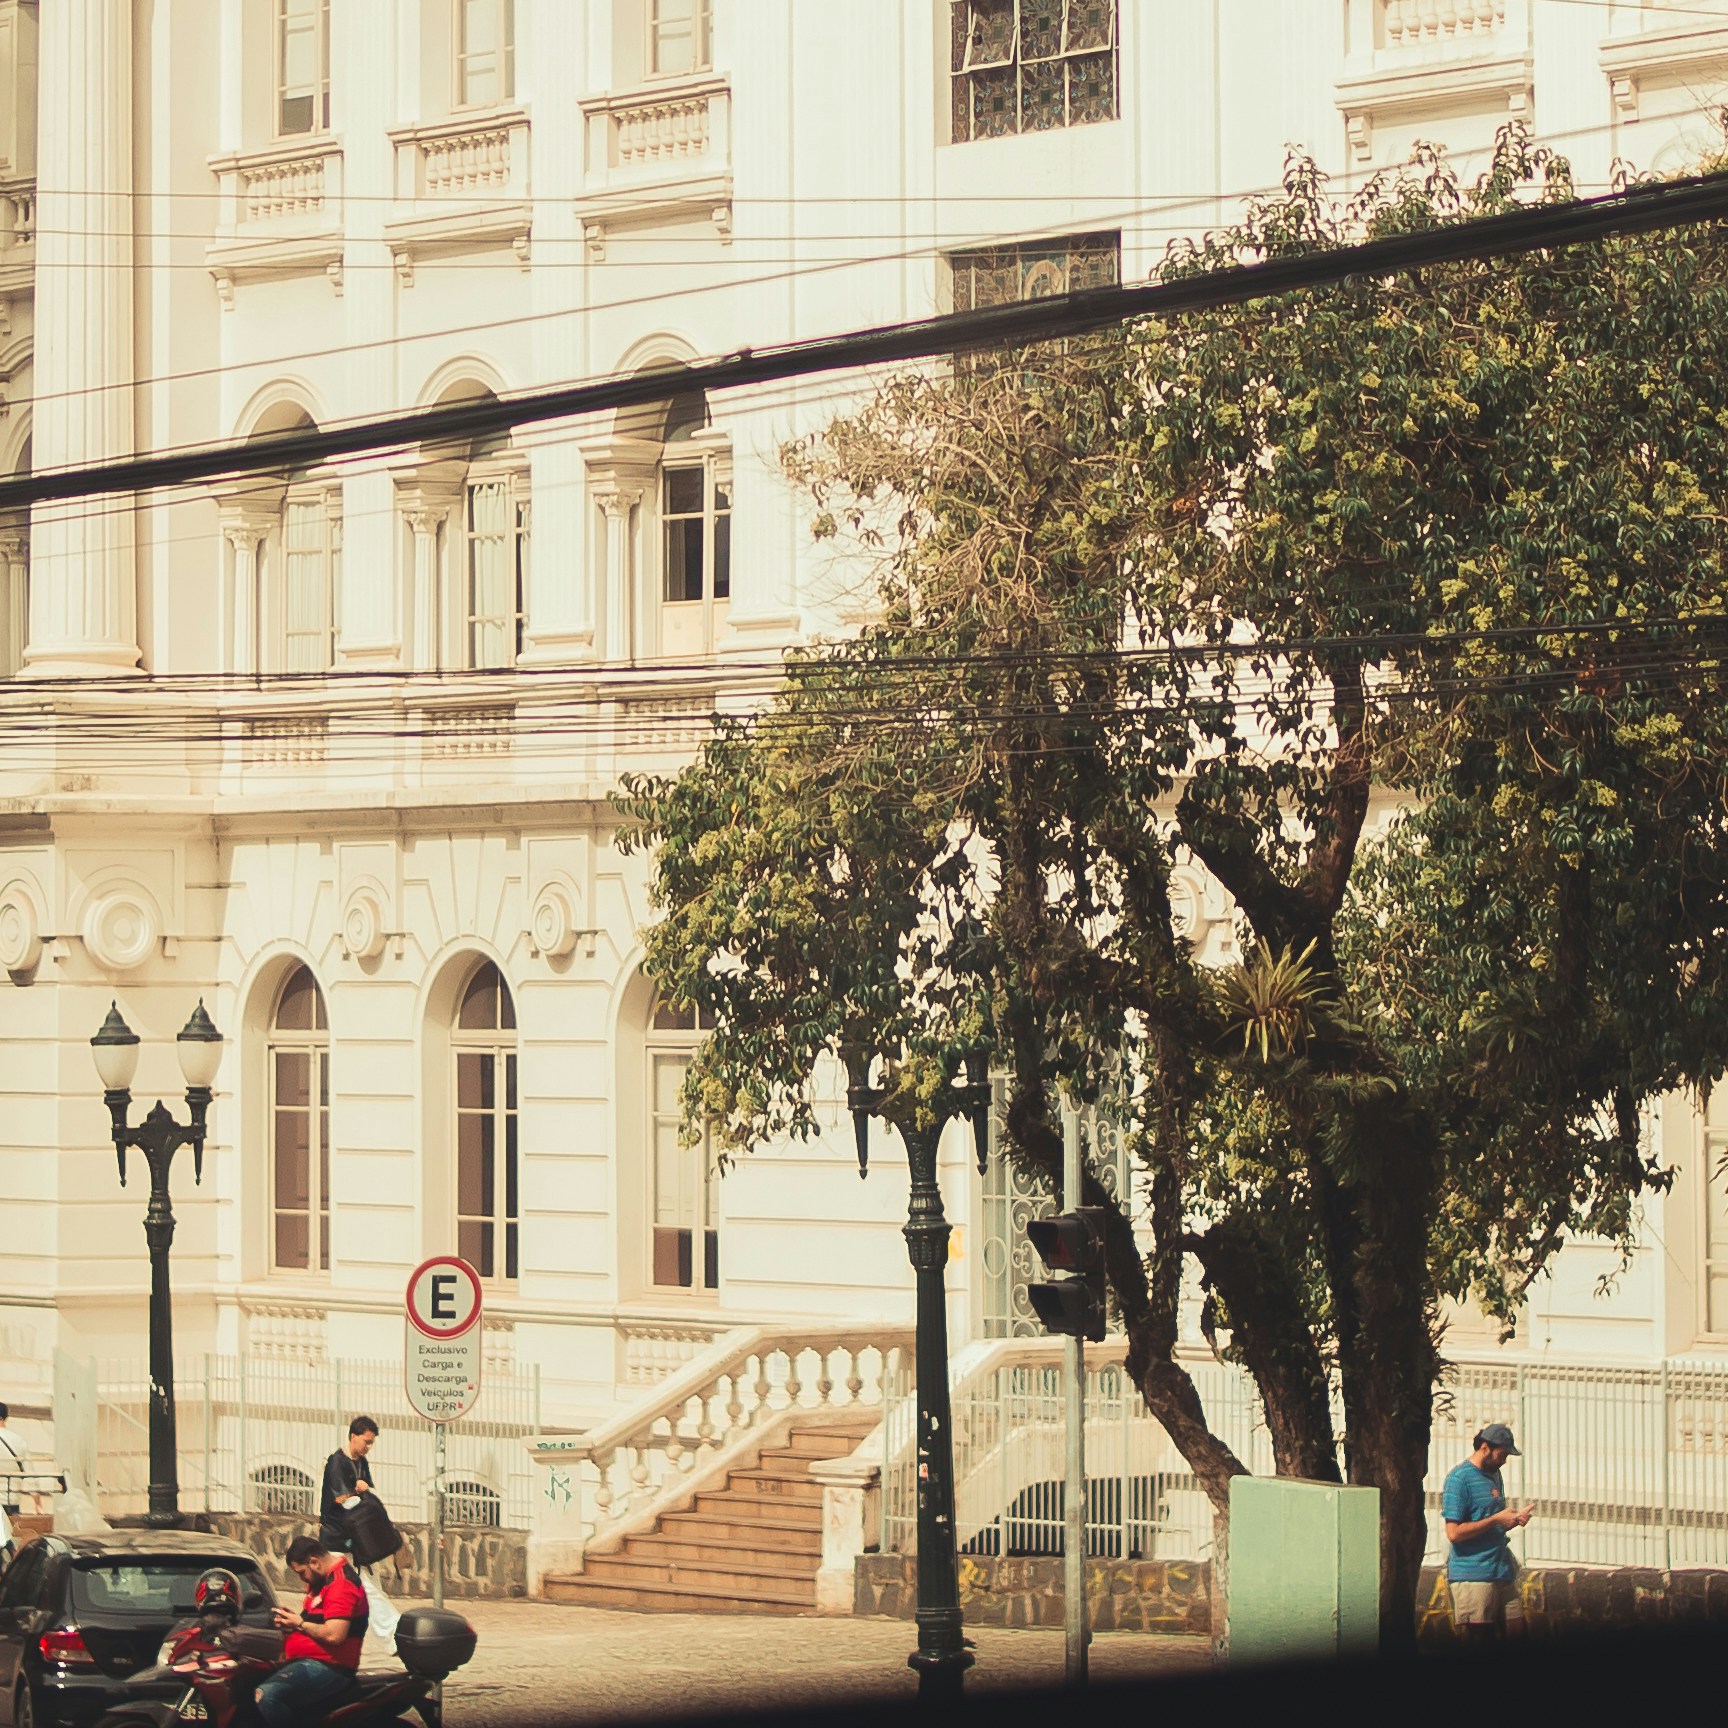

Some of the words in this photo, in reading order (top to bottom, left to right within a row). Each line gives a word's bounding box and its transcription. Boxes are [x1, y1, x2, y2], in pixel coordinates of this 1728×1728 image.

[431, 1275, 457, 1319] E
[418, 1344, 467, 1355] Exclusivo
[422, 1359, 454, 1369] Carga
[417, 1374, 467, 1385] Descarga
[427, 1402, 457, 1411] UFPR
